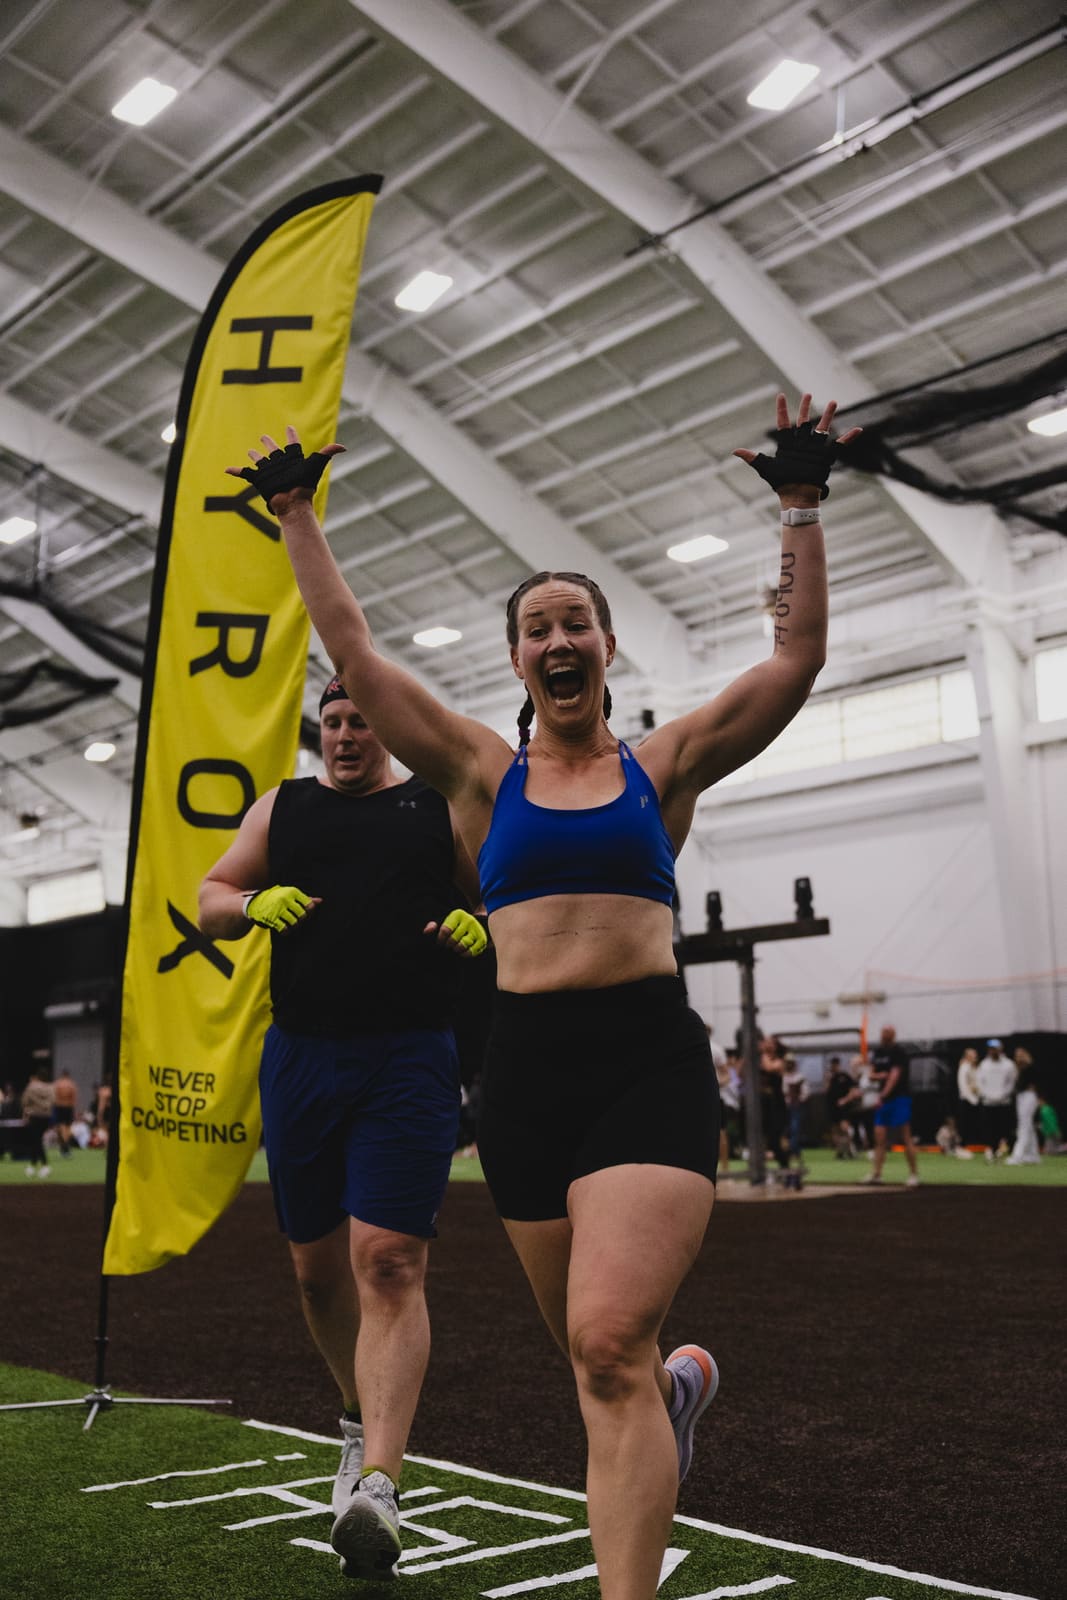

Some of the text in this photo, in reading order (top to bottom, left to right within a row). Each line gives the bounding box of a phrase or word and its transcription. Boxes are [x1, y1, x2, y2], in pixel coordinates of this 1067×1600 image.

[157, 315, 313, 980] HYROX
[149, 1065, 216, 1093] NEVER
[154, 1092, 206, 1117] STOP
[131, 1107, 247, 1144] COMPETING
